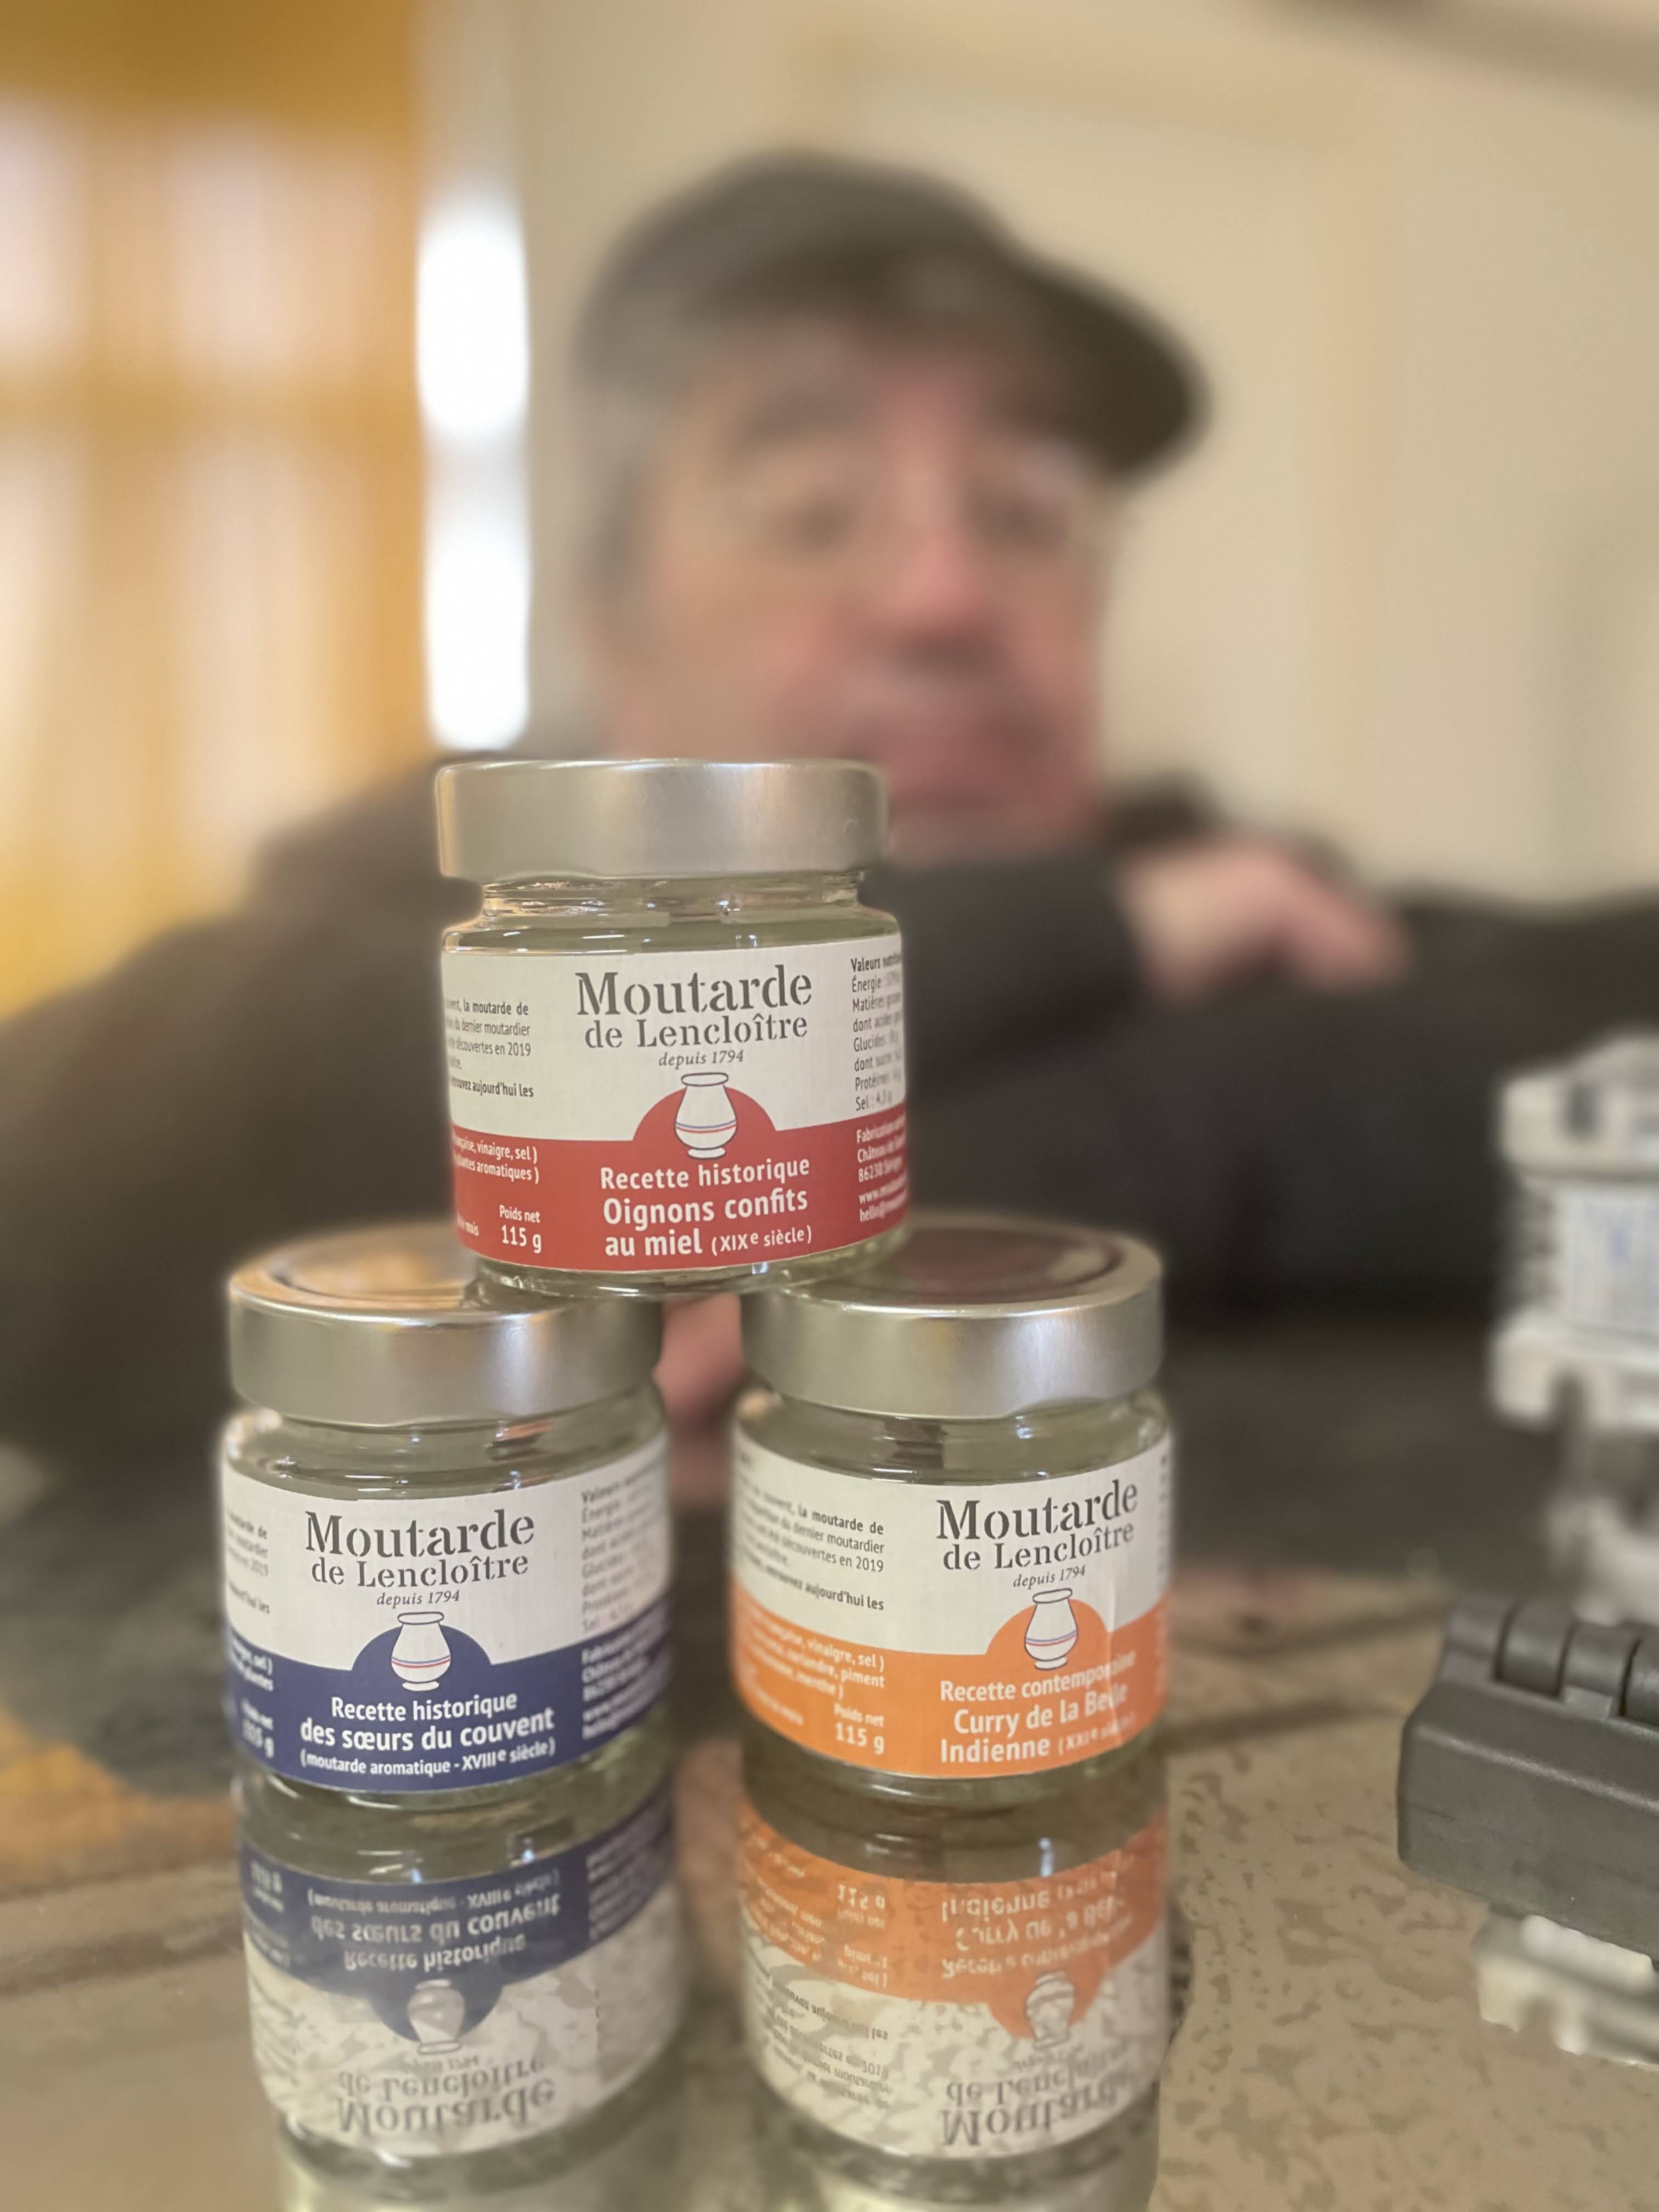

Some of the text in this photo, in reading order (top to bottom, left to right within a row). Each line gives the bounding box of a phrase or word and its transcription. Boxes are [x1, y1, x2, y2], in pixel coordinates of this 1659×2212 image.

[850, 957, 880, 972] Valeurs
[575, 964, 812, 1015] Moutarde
[464, 999, 470, 1012] la
[472, 1002, 511, 1015] moutarde
[517, 1002, 528, 1015] de
[462, 1020, 482, 1032] dernier
[484, 1023, 530, 1036] moutardier
[585, 1013, 808, 1048] de Lencloître
[853, 1017, 872, 1032] dont
[456, 1037, 493, 1054] découvertes
[495, 1044, 505, 1055] en
[508, 1042, 531, 1056] 2019
[658, 1049, 744, 1069] depuis 1794
[472, 1080, 517, 1096] aujourd'hui
[519, 1084, 534, 1097] les
[477, 1139, 513, 1160] vinaigre,
[515, 1146, 531, 1160] sel
[477, 1159, 532, 1182] aromatiques
[601, 1158, 809, 1189] Recette historique
[500, 1205, 540, 1223] Poids net
[603, 1188, 808, 1231] Oignons confits
[501, 1224, 541, 1254] 115 g
[605, 1237, 635, 1256] au
[645, 1228, 702, 1256] miel
[936, 1480, 1138, 1539] Moutarde
[305, 1509, 534, 1557] Moutarde
[812, 1510, 863, 1531] moutarde
[870, 1521, 884, 1534] de
[827, 1533, 884, 1554] moutardier
[943, 1523, 1135, 1570] de Lencloître
[312, 1555, 528, 1588] de Lencloître
[839, 1555, 851, 1567] en
[856, 1556, 884, 1572] 2019
[1013, 1565, 1086, 1589] depuis 1794
[377, 1590, 460, 1609] depuis 1794
[867, 1596, 884, 1610] les
[940, 1680, 1015, 1701] Recette
[331, 1693, 517, 1721] Recette historique
[954, 1709, 1019, 1737] Curry
[1026, 1704, 1052, 1729] de
[1060, 1699, 1079, 1723] la
[300, 1707, 555, 1751] des sœurs du couvent
[835, 1722, 884, 1755] 115 g
[941, 1738, 1050, 1763] Indienne
[300, 1749, 366, 1774] (moutarde
[370, 1759, 450, 1778] aromatique
